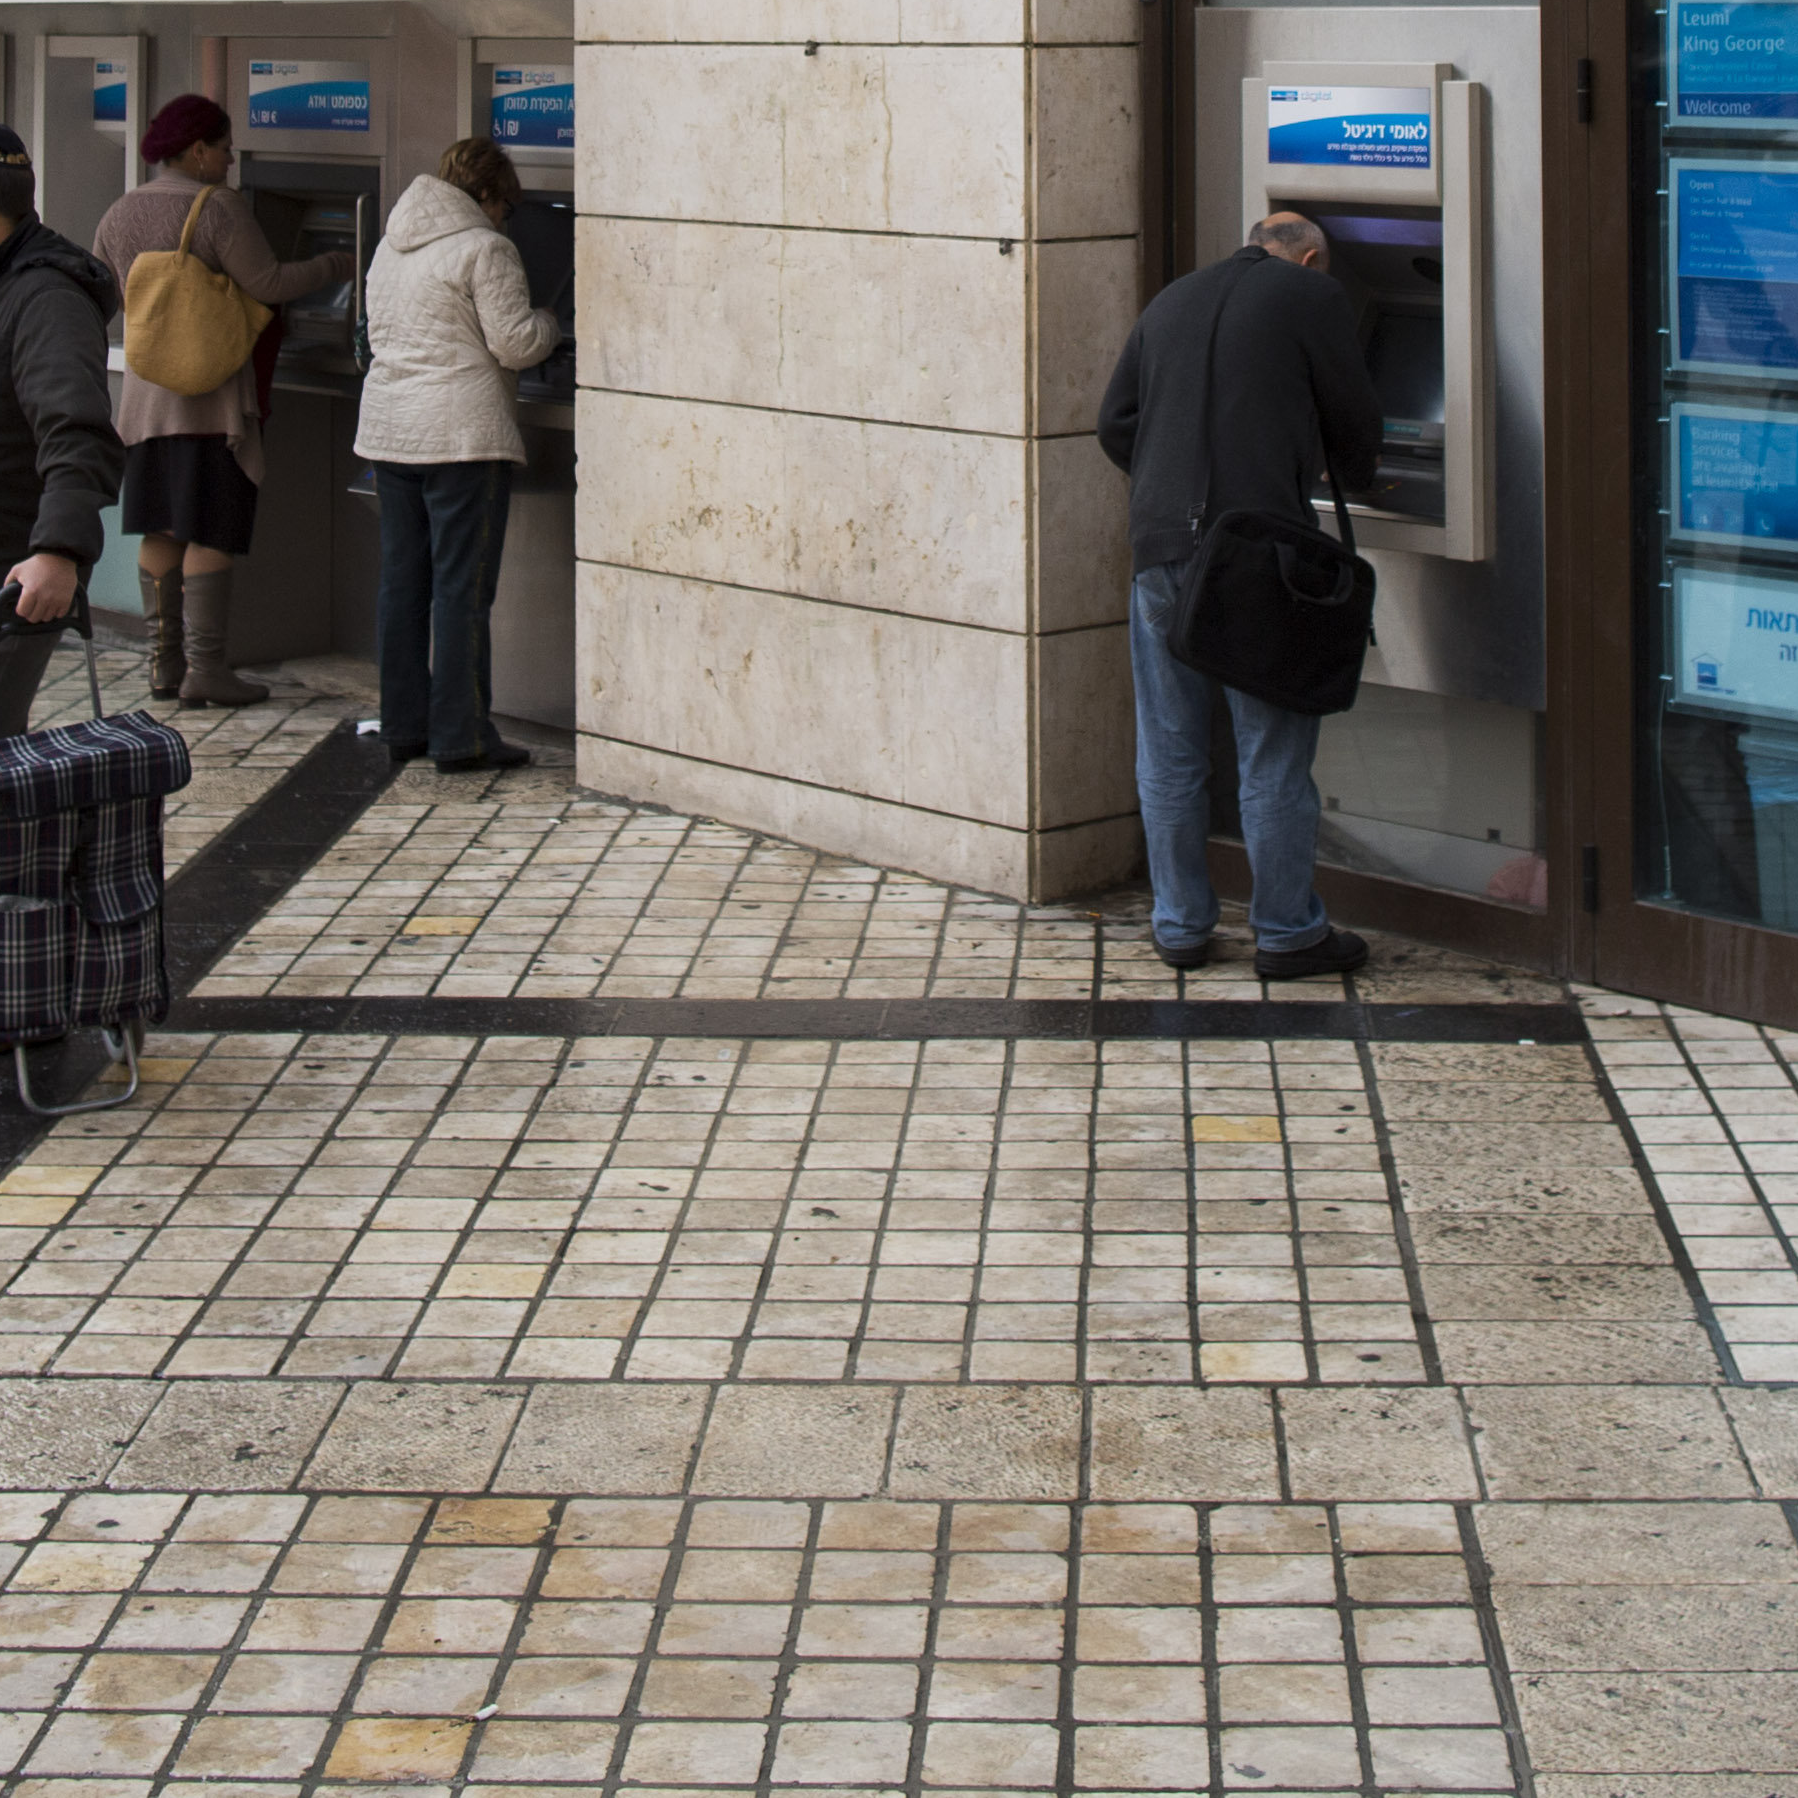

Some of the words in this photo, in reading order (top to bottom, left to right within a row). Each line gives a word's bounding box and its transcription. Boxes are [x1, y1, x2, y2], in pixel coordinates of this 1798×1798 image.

[1683, 10, 1730, 26] Leumi
[1683, 35, 1719, 54] King
[1725, 35, 1785, 54] George
[308, 95, 326, 108] ATM
[1685, 99, 1751, 116] Welcome
[1342, 120, 1385, 139] דיגיטל
[1390, 122, 1428, 140] לאומי
[1689, 180, 1715, 191] Open
[1779, 644, 1798, 662] זה
